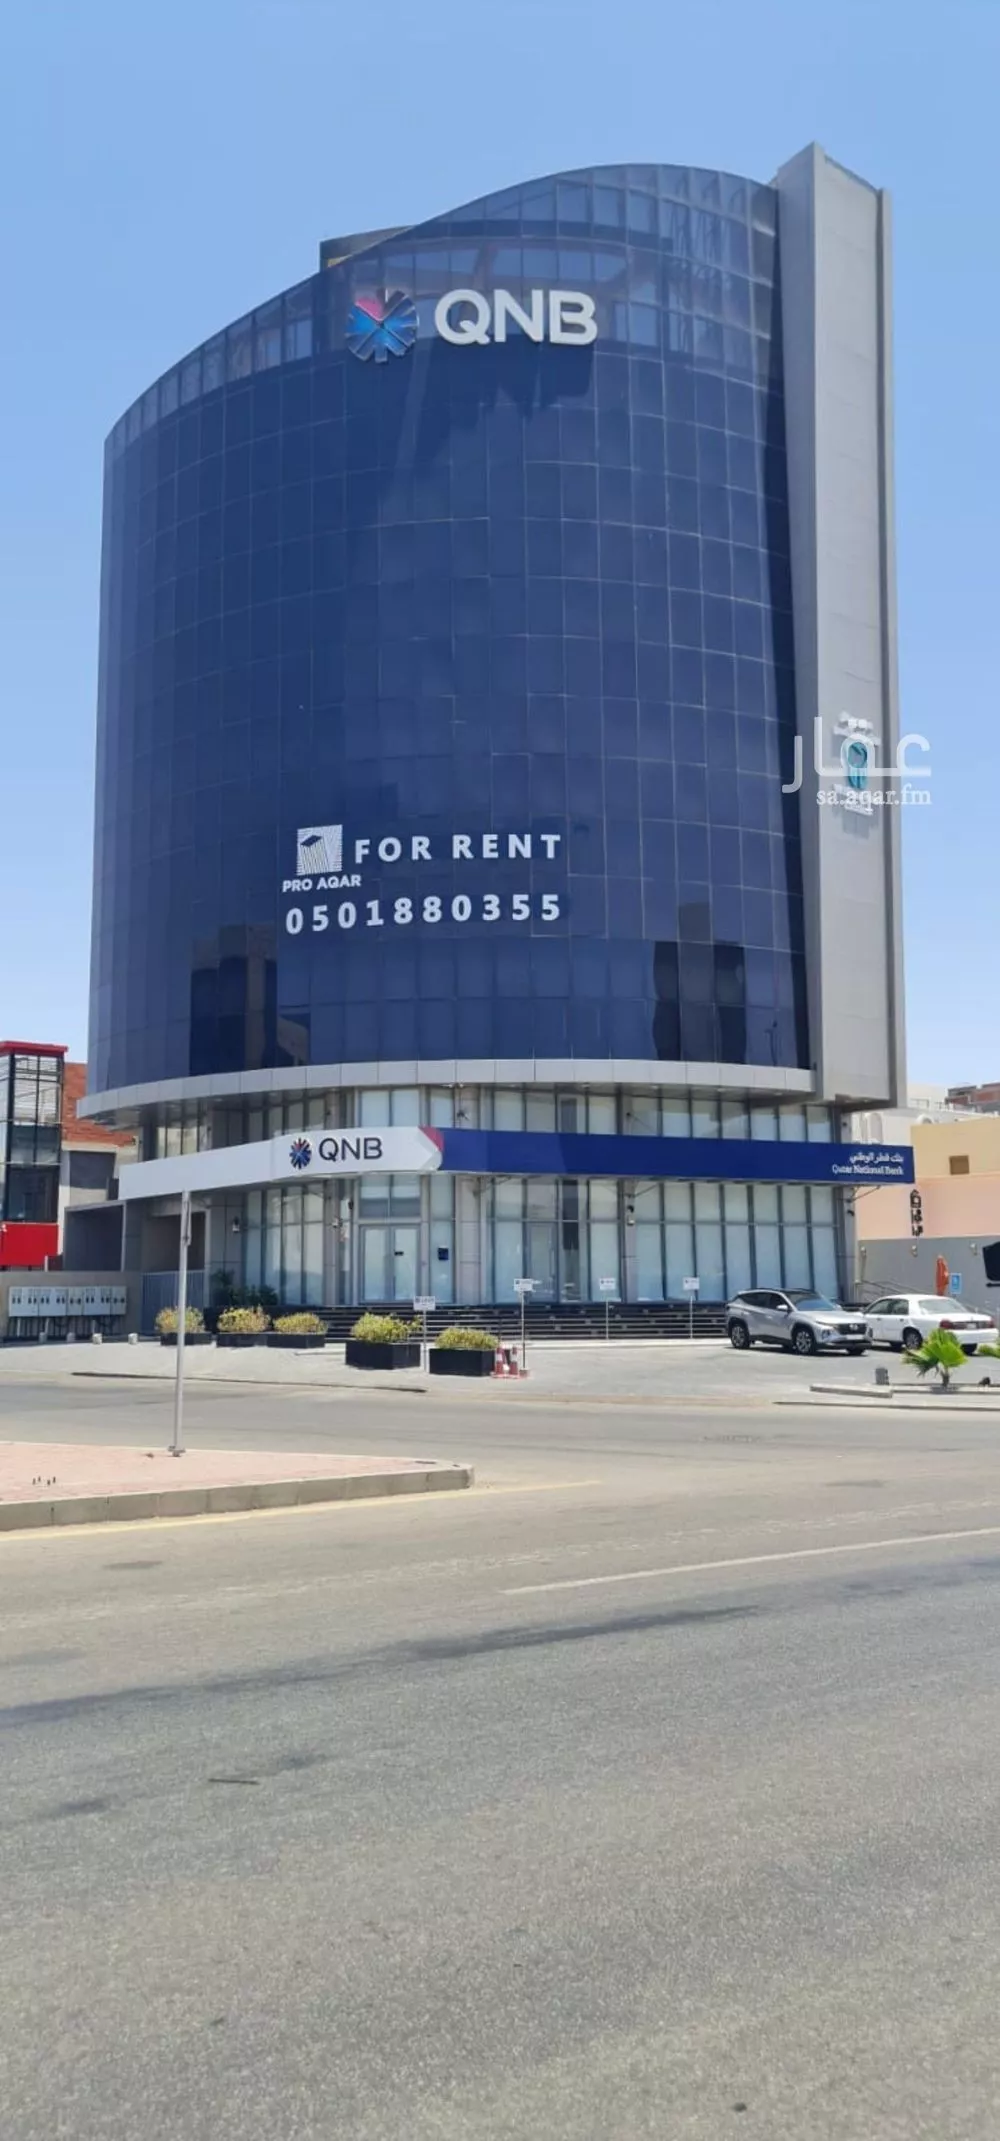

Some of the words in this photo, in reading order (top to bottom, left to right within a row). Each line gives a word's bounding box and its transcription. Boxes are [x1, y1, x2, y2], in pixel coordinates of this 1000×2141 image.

[435, 289, 598, 345] QNB
[355, 836, 432, 863] FOR
[452, 834, 561, 859] RENT
[282, 878, 313, 892] PRO
[316, 874, 362, 890] AQAR
[285, 894, 561, 935] 0501880355
[318, 1137, 383, 1162] QNB
